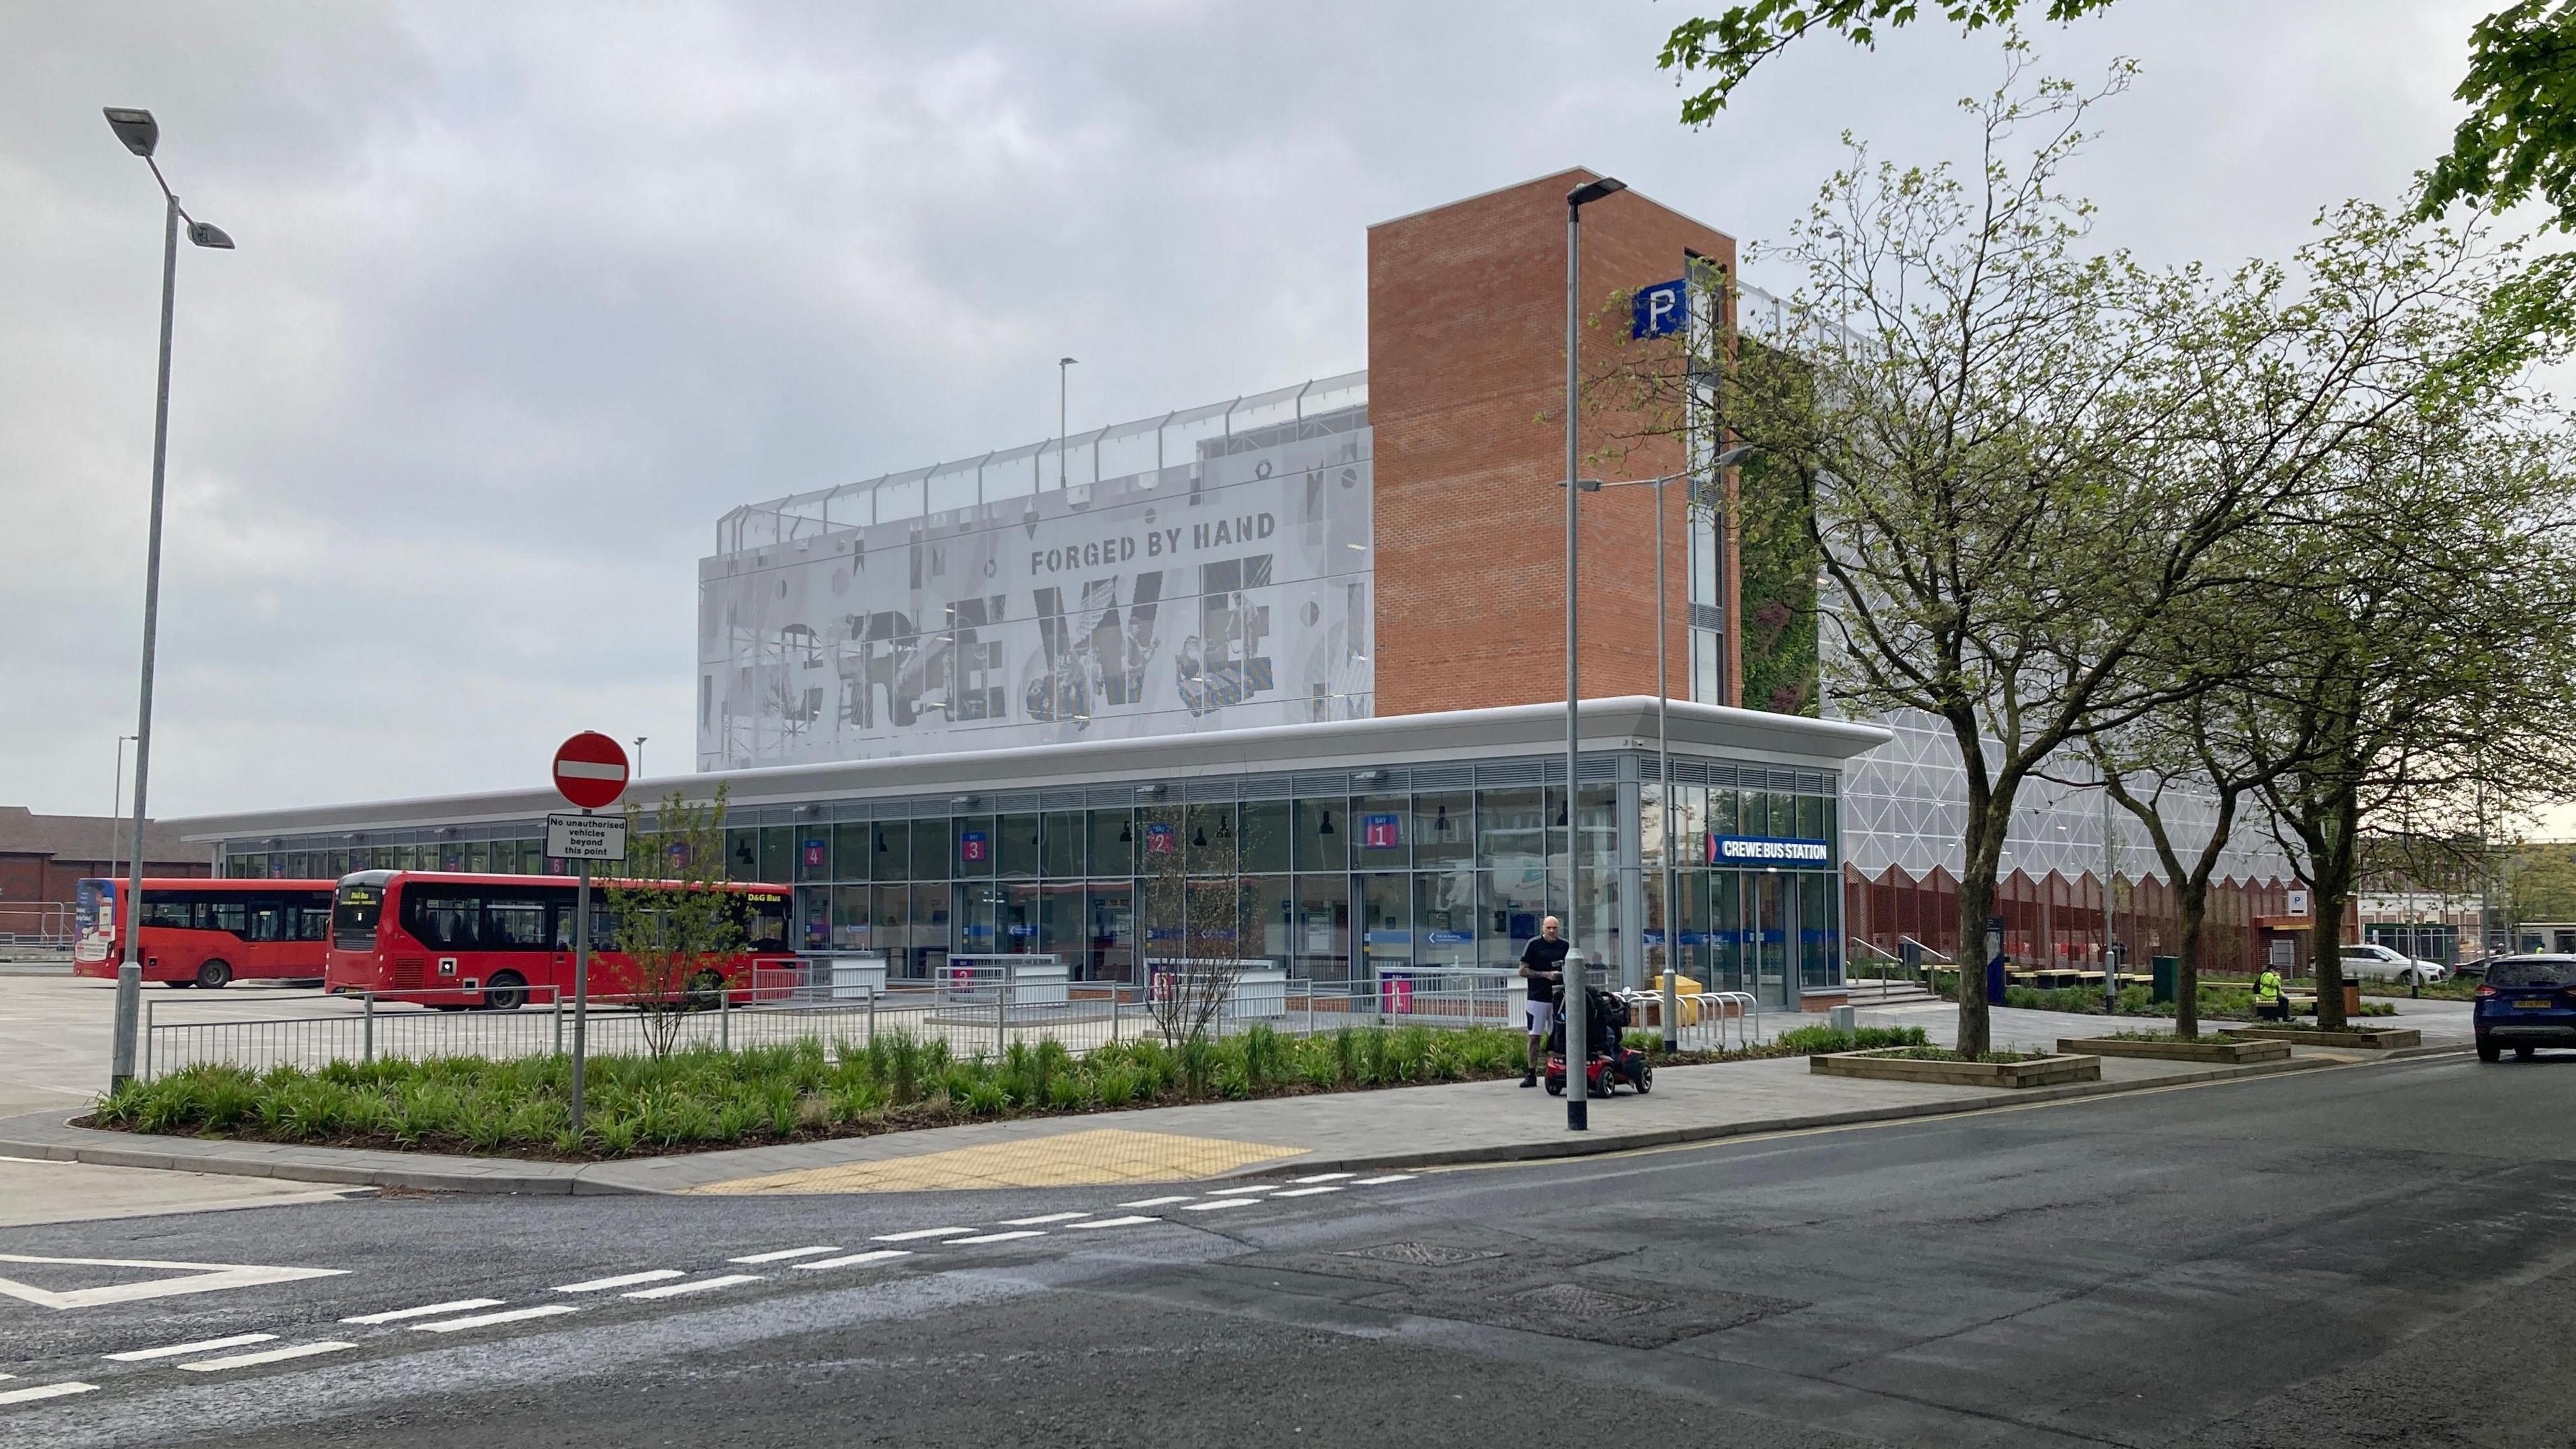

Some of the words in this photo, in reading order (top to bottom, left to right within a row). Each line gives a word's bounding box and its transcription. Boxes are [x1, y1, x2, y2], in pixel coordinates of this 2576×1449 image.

[1650, 289, 1676, 332] P
[1032, 536, 1136, 576] FORGED
[1148, 527, 1182, 557] BY
[1193, 512, 1275, 550] HAND
[566, 820, 625, 829] unauthorised
[569, 829, 605, 837] vehicles
[1375, 826, 1387, 845] 1
[570, 837, 602, 847] beyond
[1155, 834, 1165, 852] 2
[584, 848, 607, 856] point
[810, 848, 818, 864] 4
[969, 841, 978, 859] 3
[1722, 841, 1762, 857] CREWE
[1764, 843, 1785, 859] BUS
[1785, 843, 1827, 860] STATION
[553, 859, 560, 872] 6
[747, 894, 765, 902] D&G
[2294, 896, 2301, 904] P
